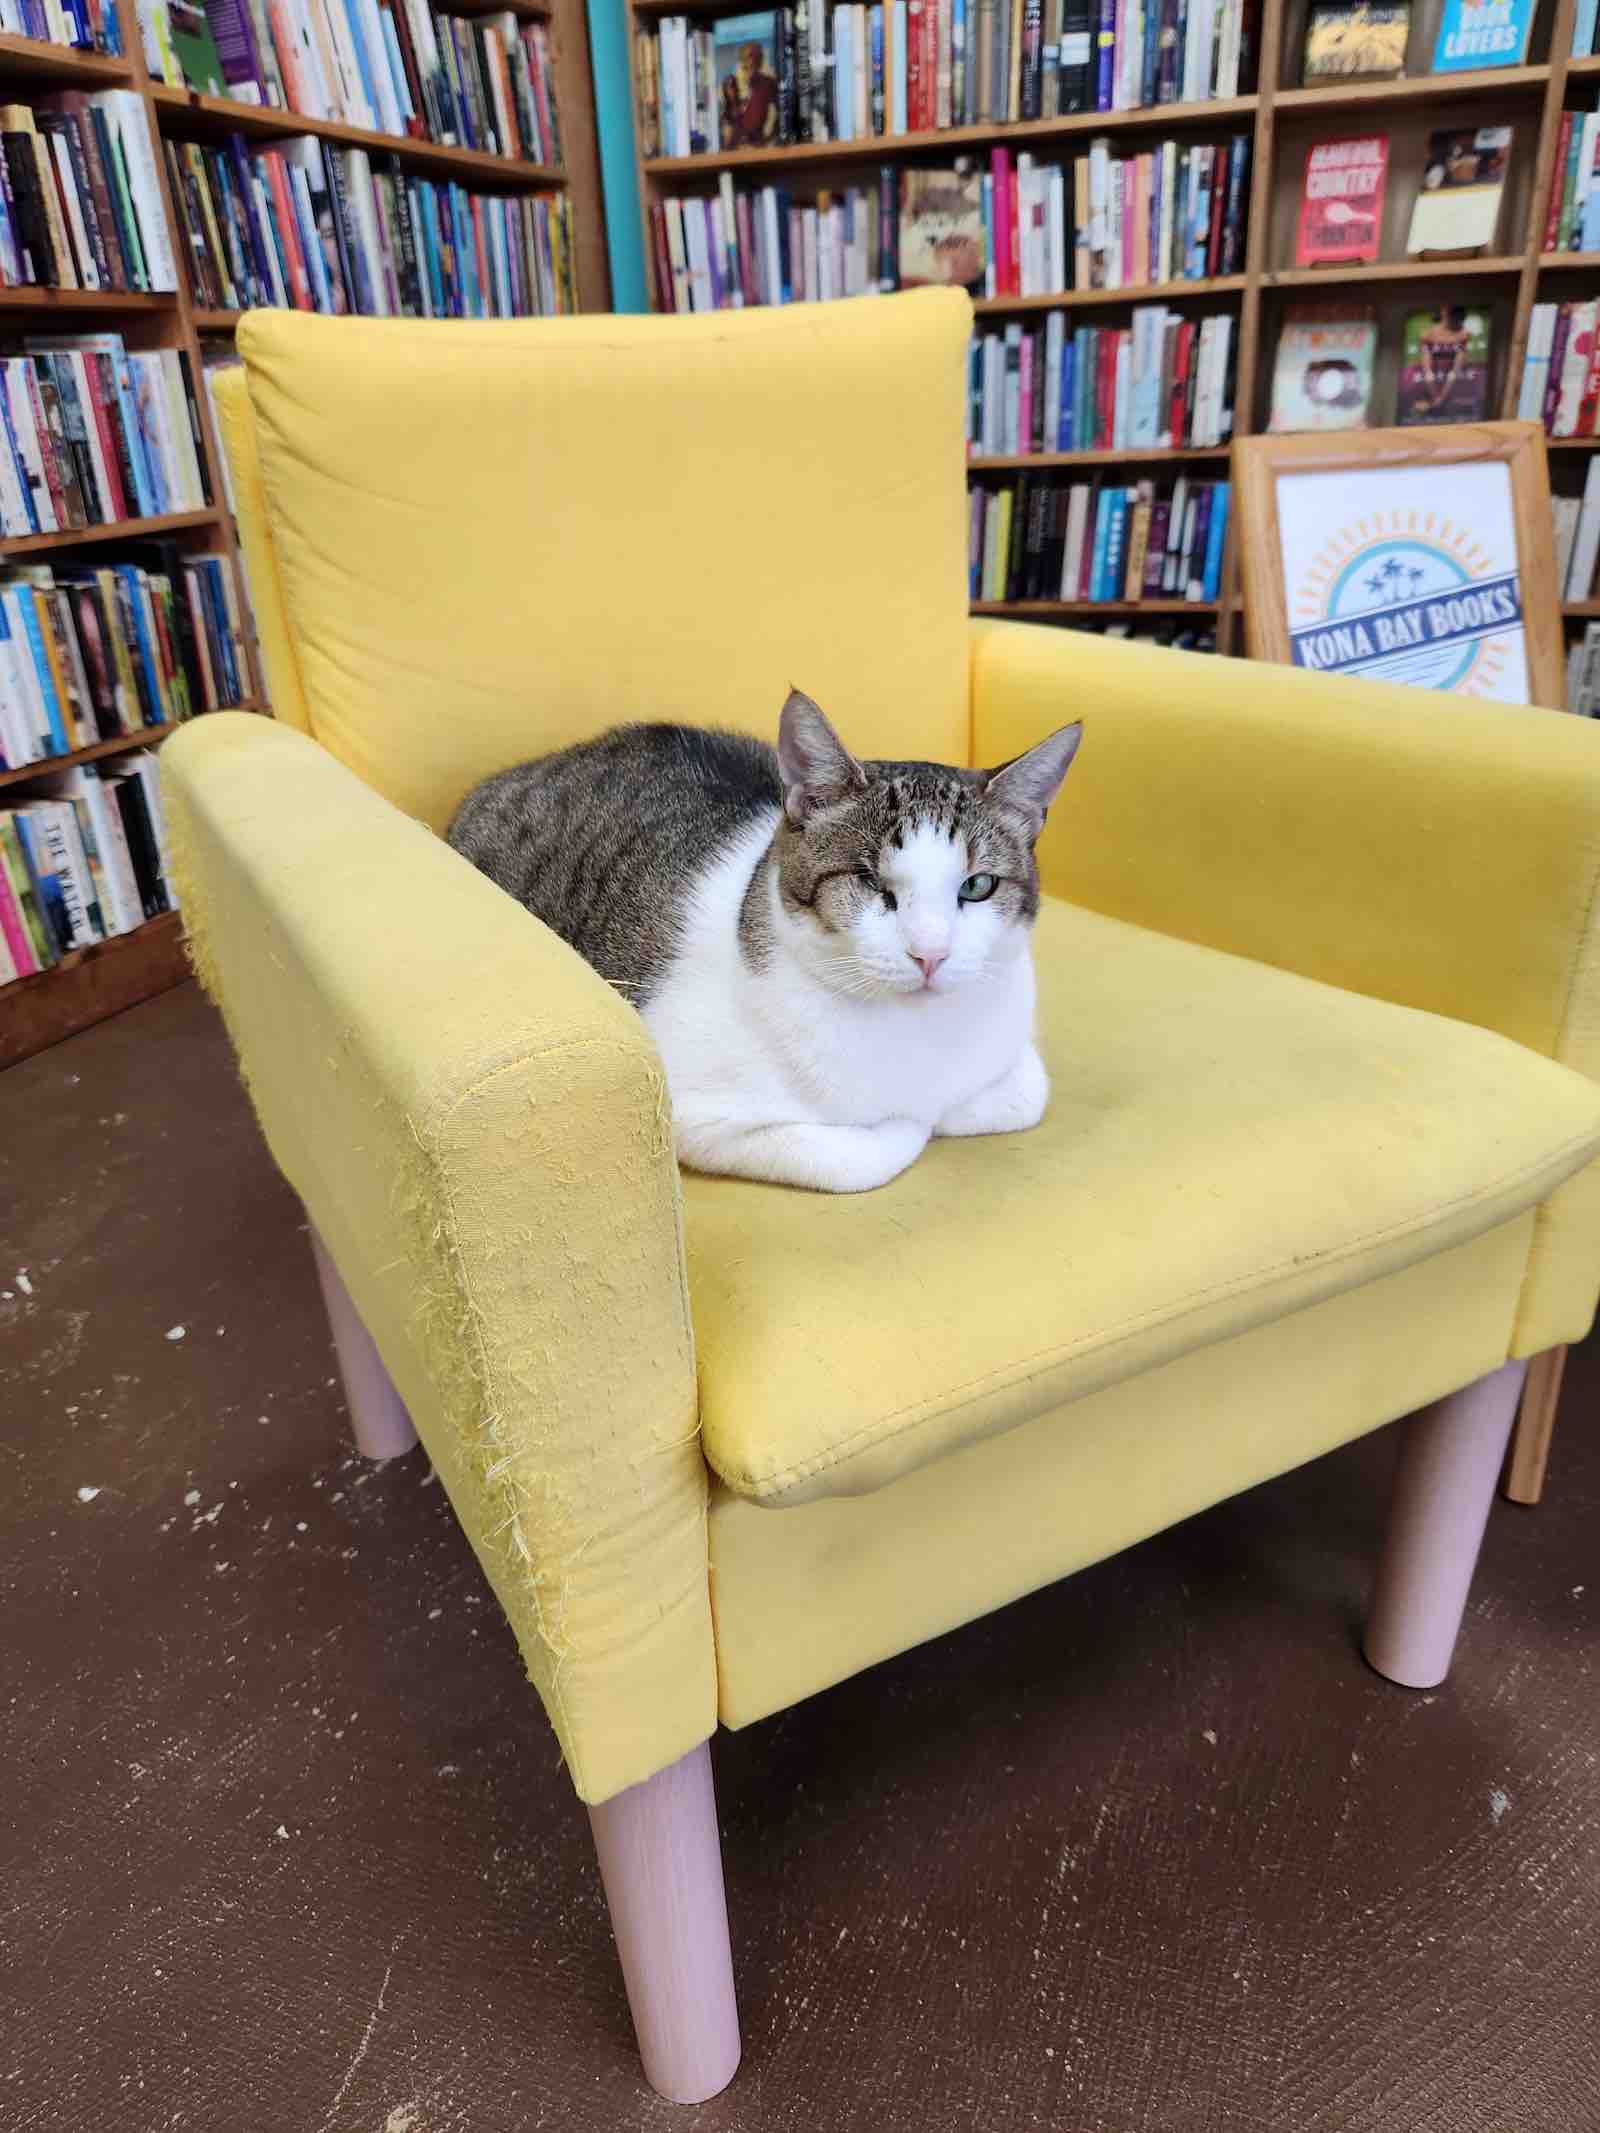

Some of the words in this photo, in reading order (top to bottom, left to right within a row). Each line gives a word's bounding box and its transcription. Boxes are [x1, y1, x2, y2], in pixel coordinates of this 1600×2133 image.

[1443, 25, 1519, 57] LOVERS
[1300, 625, 1373, 669] KONA
[1375, 609, 1427, 651] BAY
[1428, 586, 1517, 638] BOOKS
